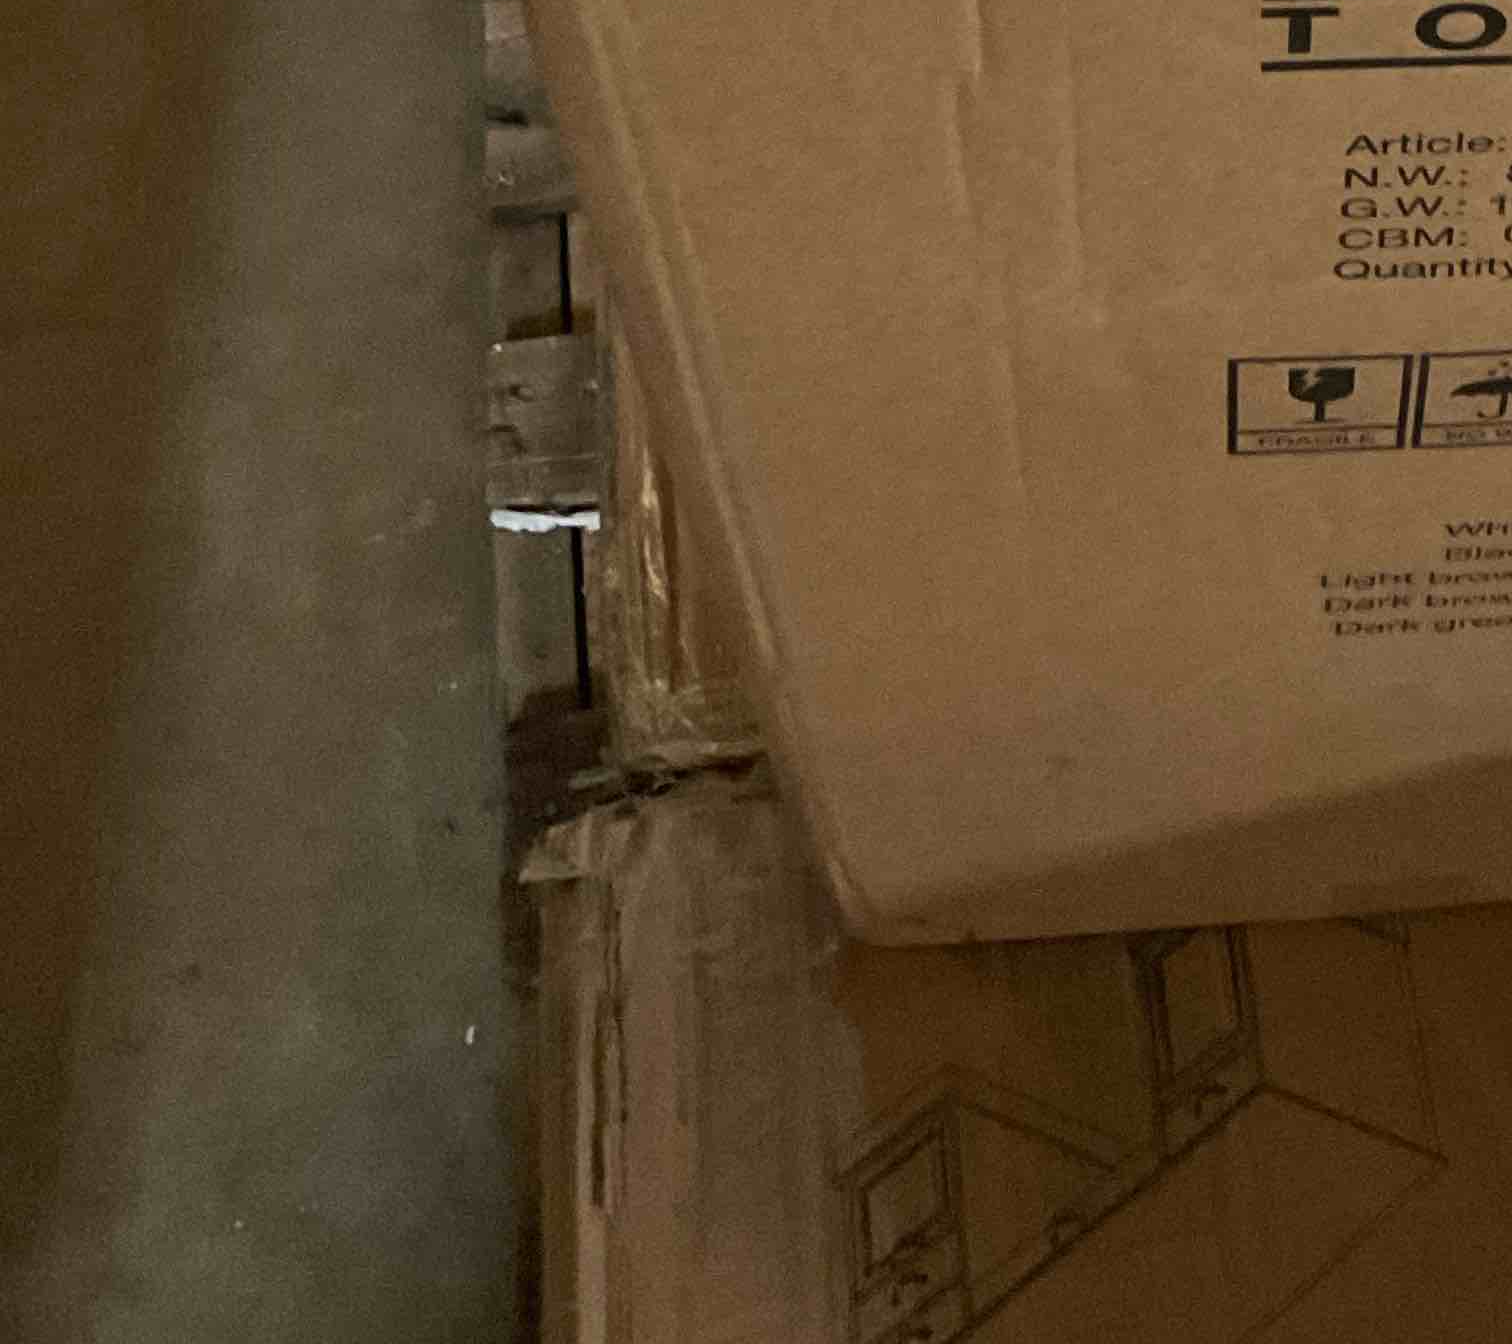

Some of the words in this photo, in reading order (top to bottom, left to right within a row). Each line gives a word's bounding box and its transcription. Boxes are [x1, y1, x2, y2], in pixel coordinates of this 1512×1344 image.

[1345, 130, 1506, 156] Article:
[1343, 165, 1470, 190] N.W.:
[1340, 194, 1467, 220] G.W.:
[1338, 224, 1470, 249] CBM:
[1319, 572, 1417, 590] Light
[1323, 594, 1412, 613] Dark
[1335, 619, 1420, 637] Dark
